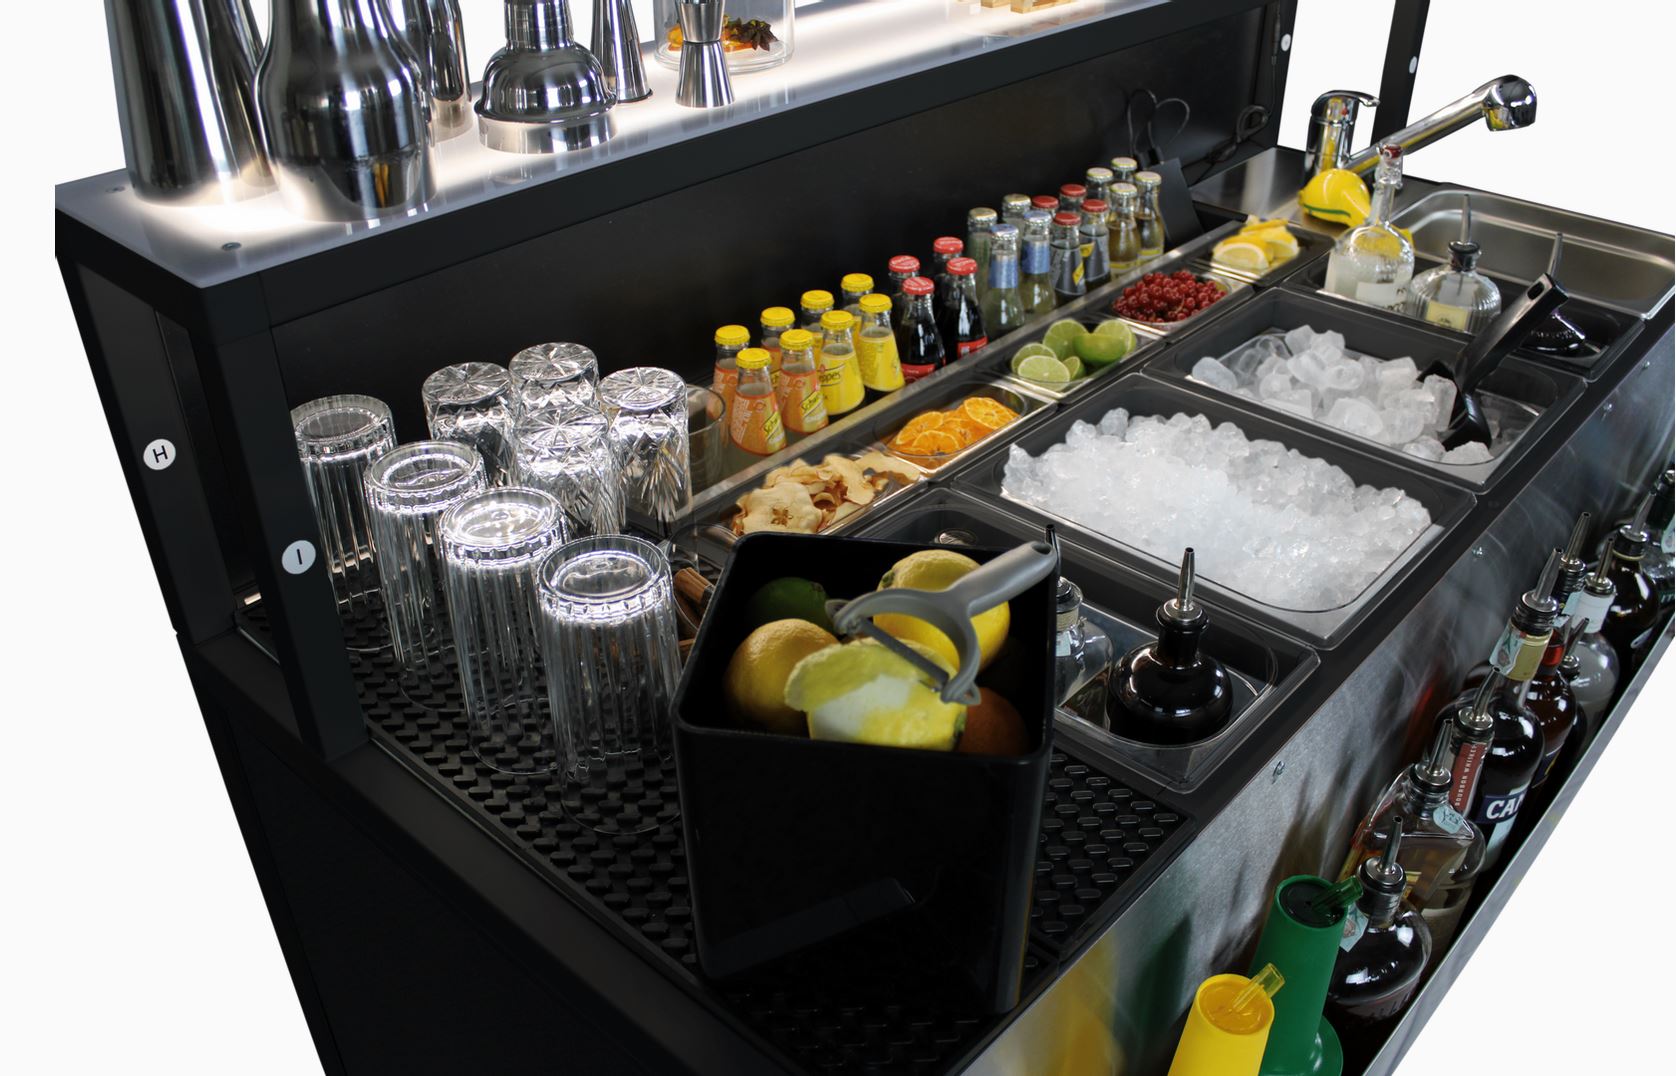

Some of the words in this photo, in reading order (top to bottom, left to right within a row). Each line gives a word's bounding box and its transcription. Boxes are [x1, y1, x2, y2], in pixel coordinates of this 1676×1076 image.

[152, 445, 168, 463] H
[296, 548, 303, 565] I
[1454, 775, 1468, 807] BOURBON
